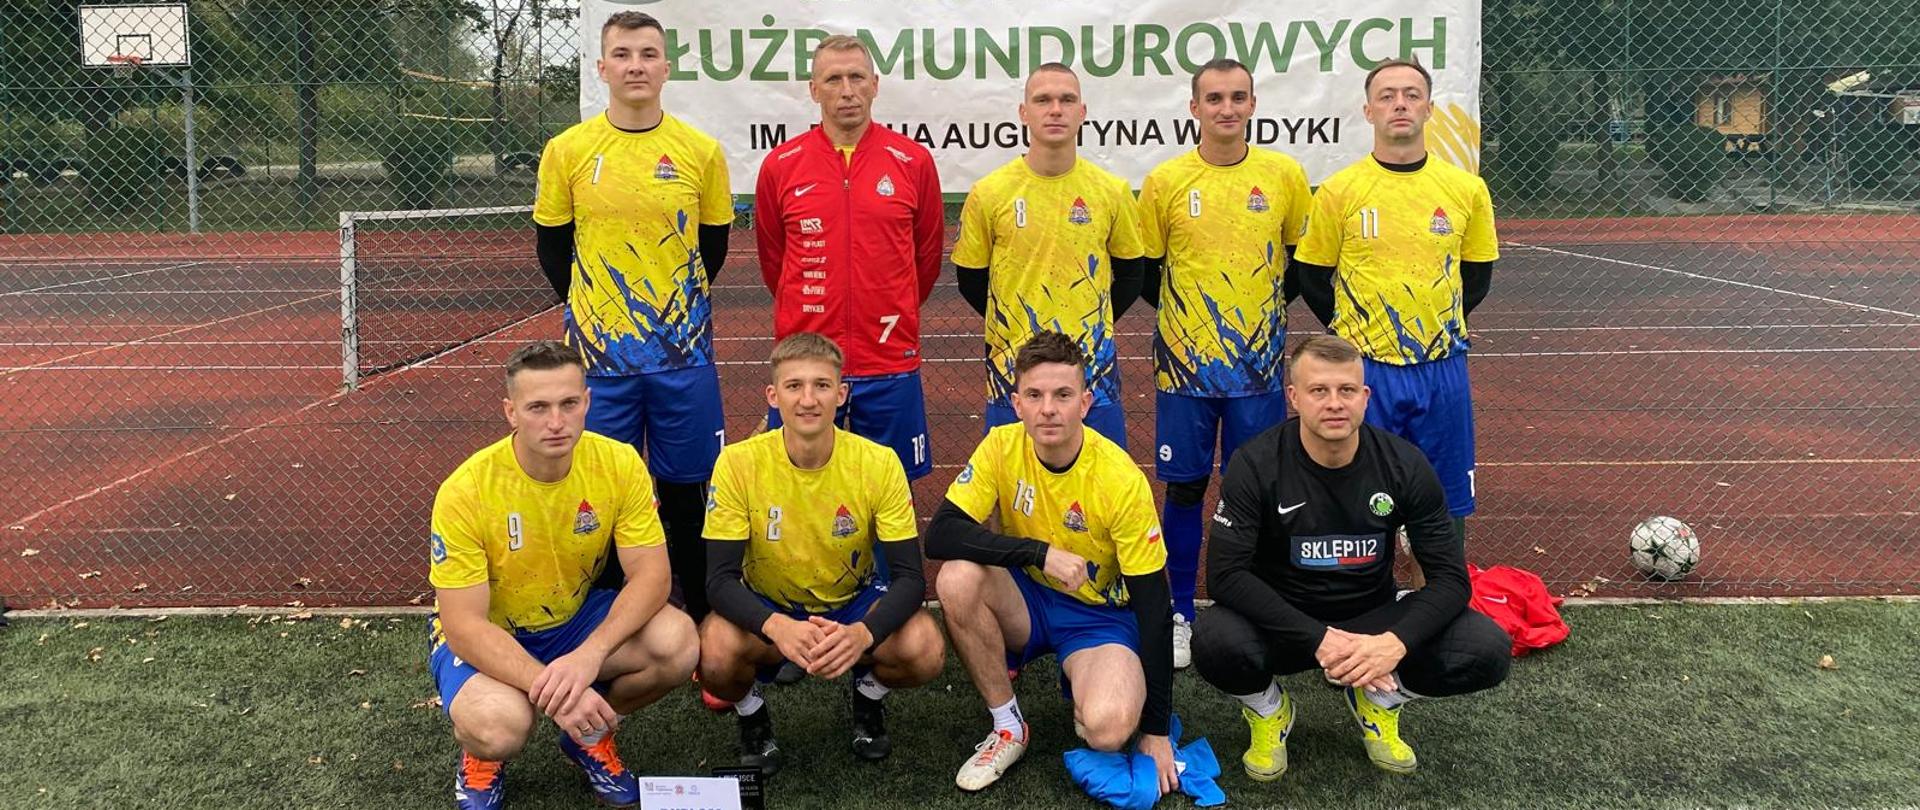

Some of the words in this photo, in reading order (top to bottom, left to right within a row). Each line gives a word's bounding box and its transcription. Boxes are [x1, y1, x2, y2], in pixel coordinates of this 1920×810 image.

[664, 14, 830, 81] ŁUŻB
[856, 17, 1446, 80] MUNDUROWYCH
[941, 119, 1166, 149] AUGTYNA
[1173, 117, 1340, 146] WJDYKI
[591, 153, 605, 185] 1
[1014, 198, 1027, 228] 8
[1188, 189, 1202, 217] 6
[1360, 207, 1379, 239] 11
[878, 315, 900, 344] 7
[911, 433, 926, 465] 18
[1013, 479, 1037, 518] 15
[506, 512, 524, 551] 9
[766, 505, 783, 541] 2
[1301, 539, 1376, 560] SKLEP112
